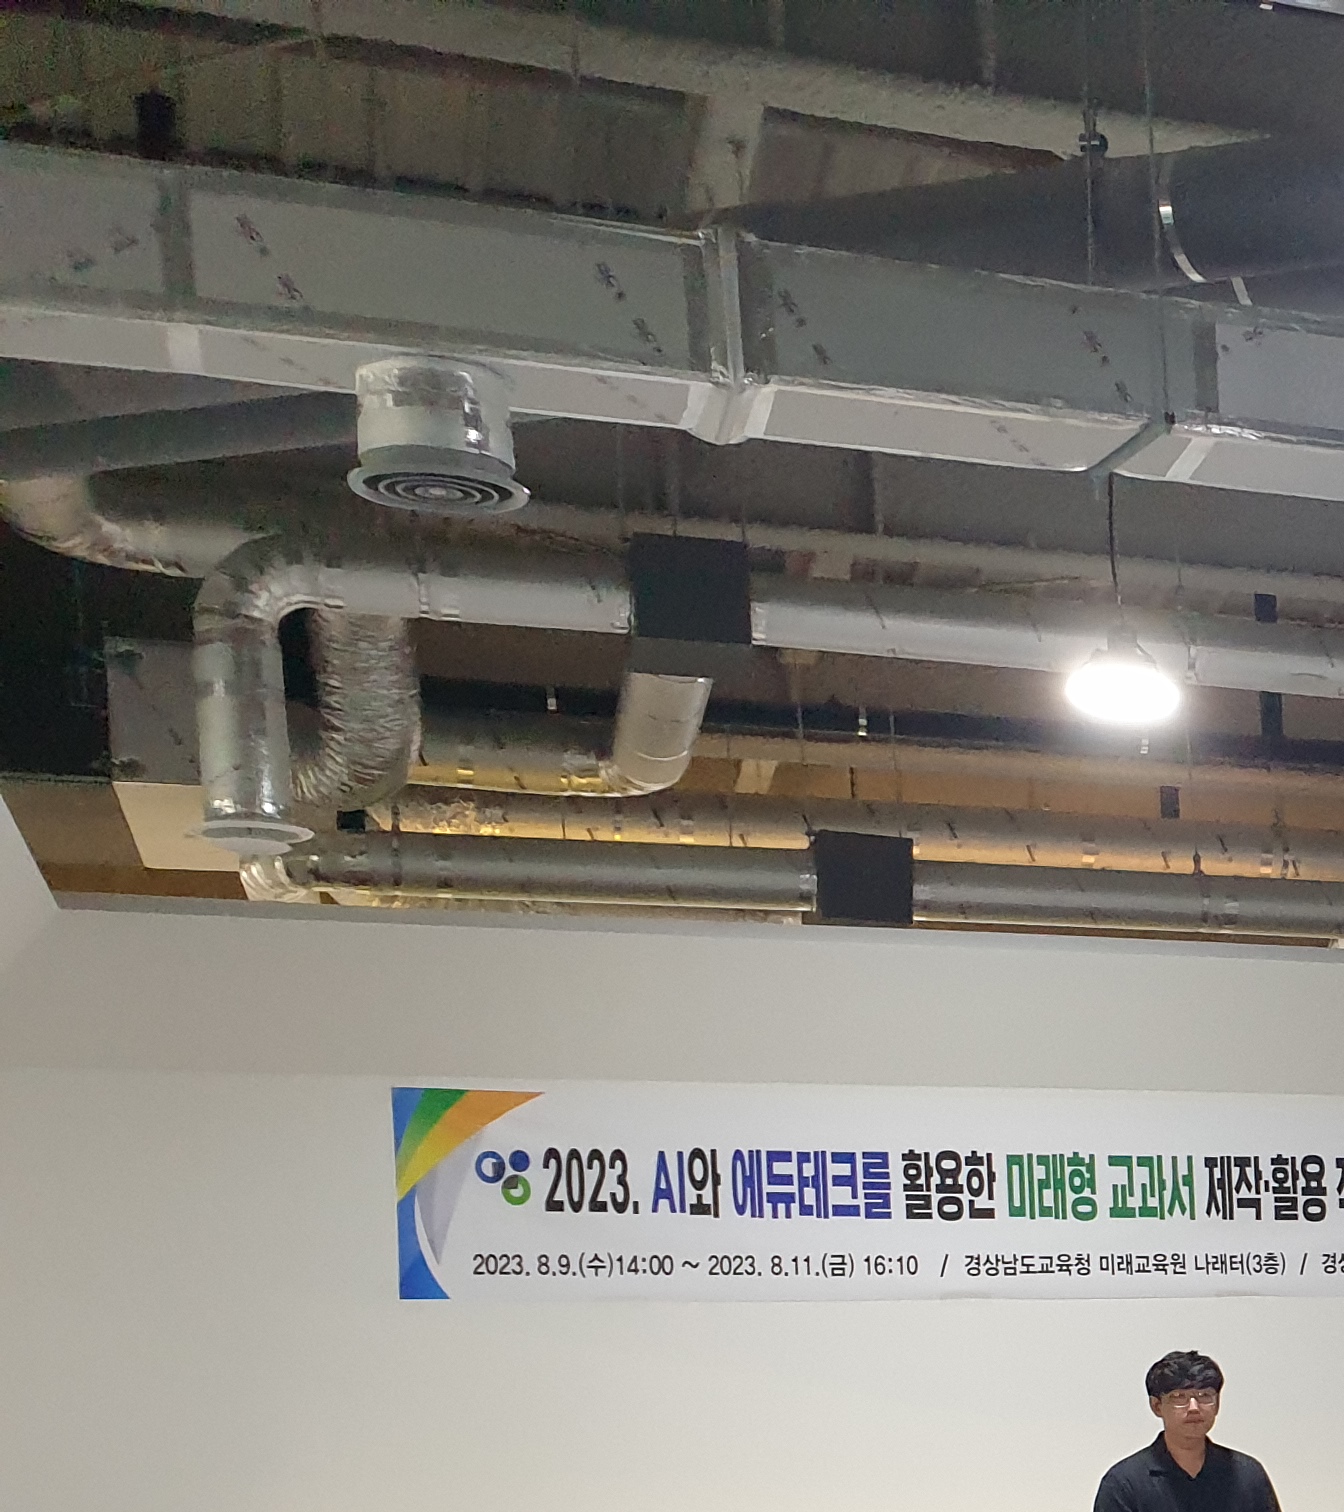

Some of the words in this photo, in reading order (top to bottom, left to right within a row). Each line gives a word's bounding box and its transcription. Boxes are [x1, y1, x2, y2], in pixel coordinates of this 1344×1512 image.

[542, 1147, 640, 1215] 2023.
[651, 1148, 721, 1219] AI와
[731, 1149, 893, 1220] 에듀테크를
[901, 1149, 996, 1221] 활용한
[1005, 1152, 1097, 1221] 미래형
[1108, 1154, 1195, 1221] 교과서
[472, 1253, 530, 1277] 2023.
[708, 1254, 763, 1277] 2023.
[770, 1252, 855, 1279] 8.11.(금)
[863, 1254, 918, 1276] 16:10
[964, 1253, 1092, 1277] 경상남도교육청
[1099, 1252, 1187, 1276] 미래교육원
[1194, 1252, 1287, 1276] 나래터(3층)
